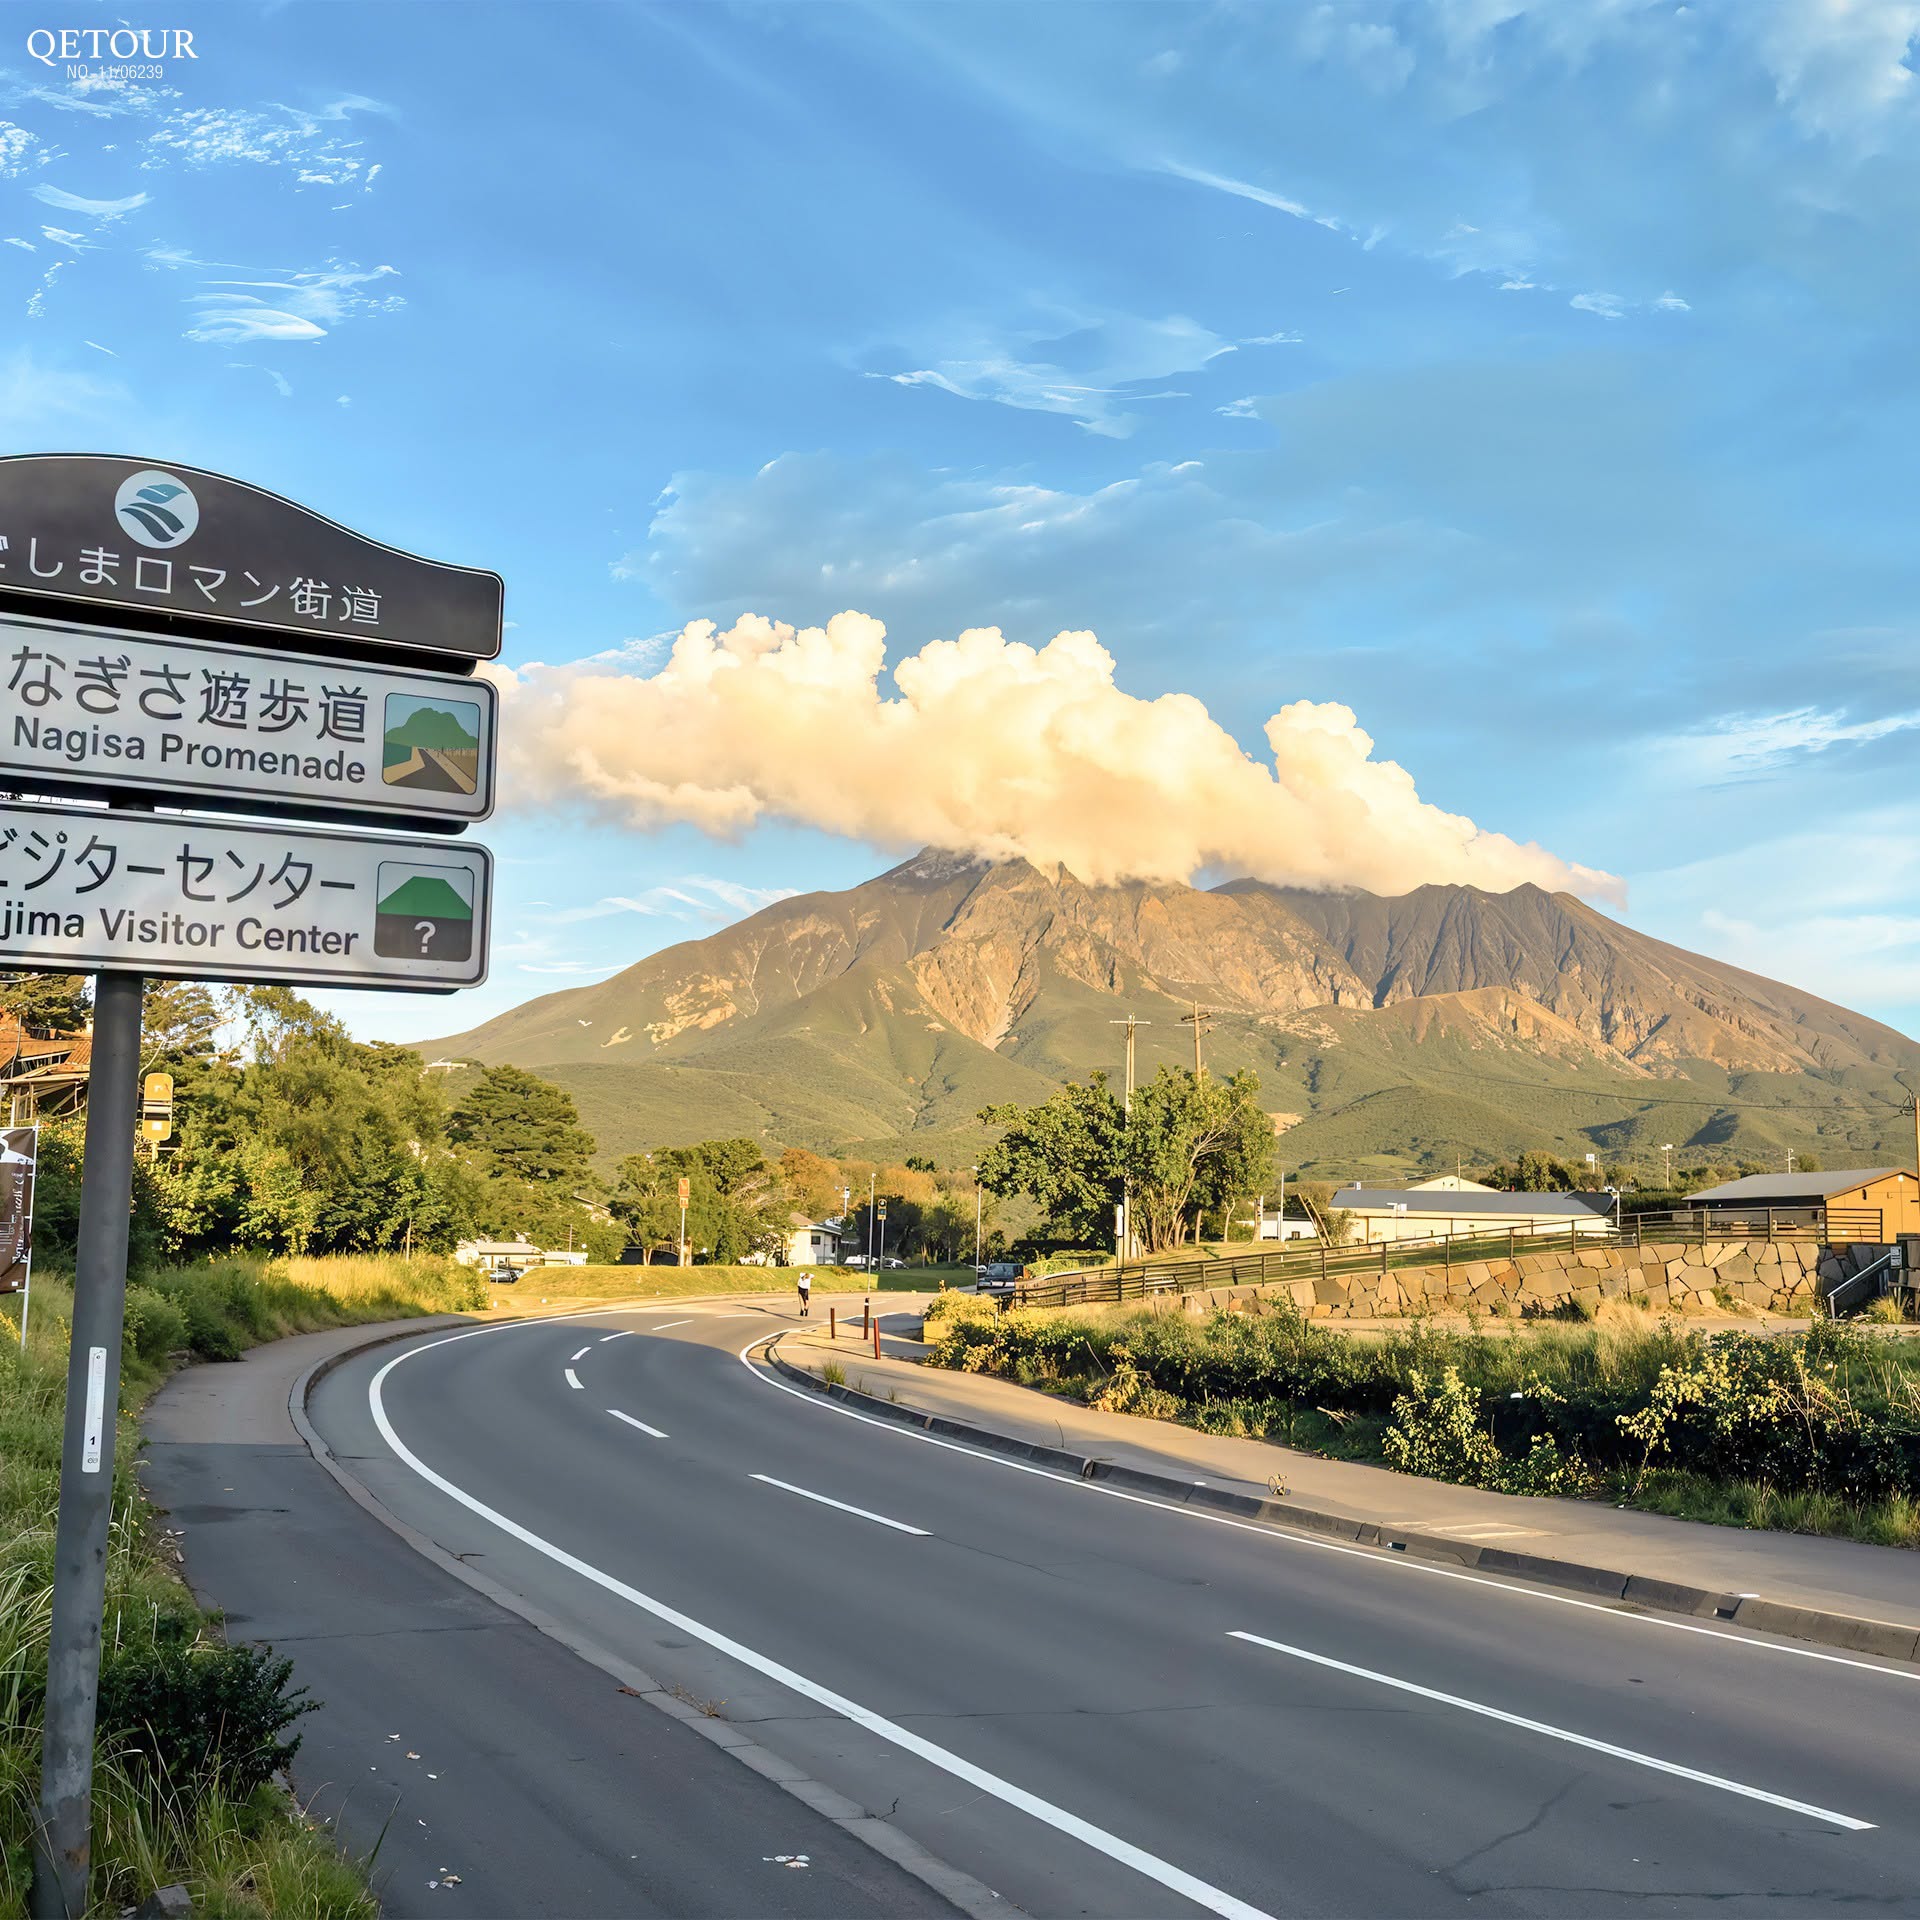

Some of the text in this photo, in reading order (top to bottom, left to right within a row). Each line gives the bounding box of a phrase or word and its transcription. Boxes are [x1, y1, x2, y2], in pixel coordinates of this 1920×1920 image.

[0, 535, 382, 625] しまロマン街道
[7, 645, 368, 744] なぎさ遊歩道
[14, 715, 366, 783] Nagisa Promenade
[99, 908, 225, 947] Visitor
[236, 917, 359, 955] Center
